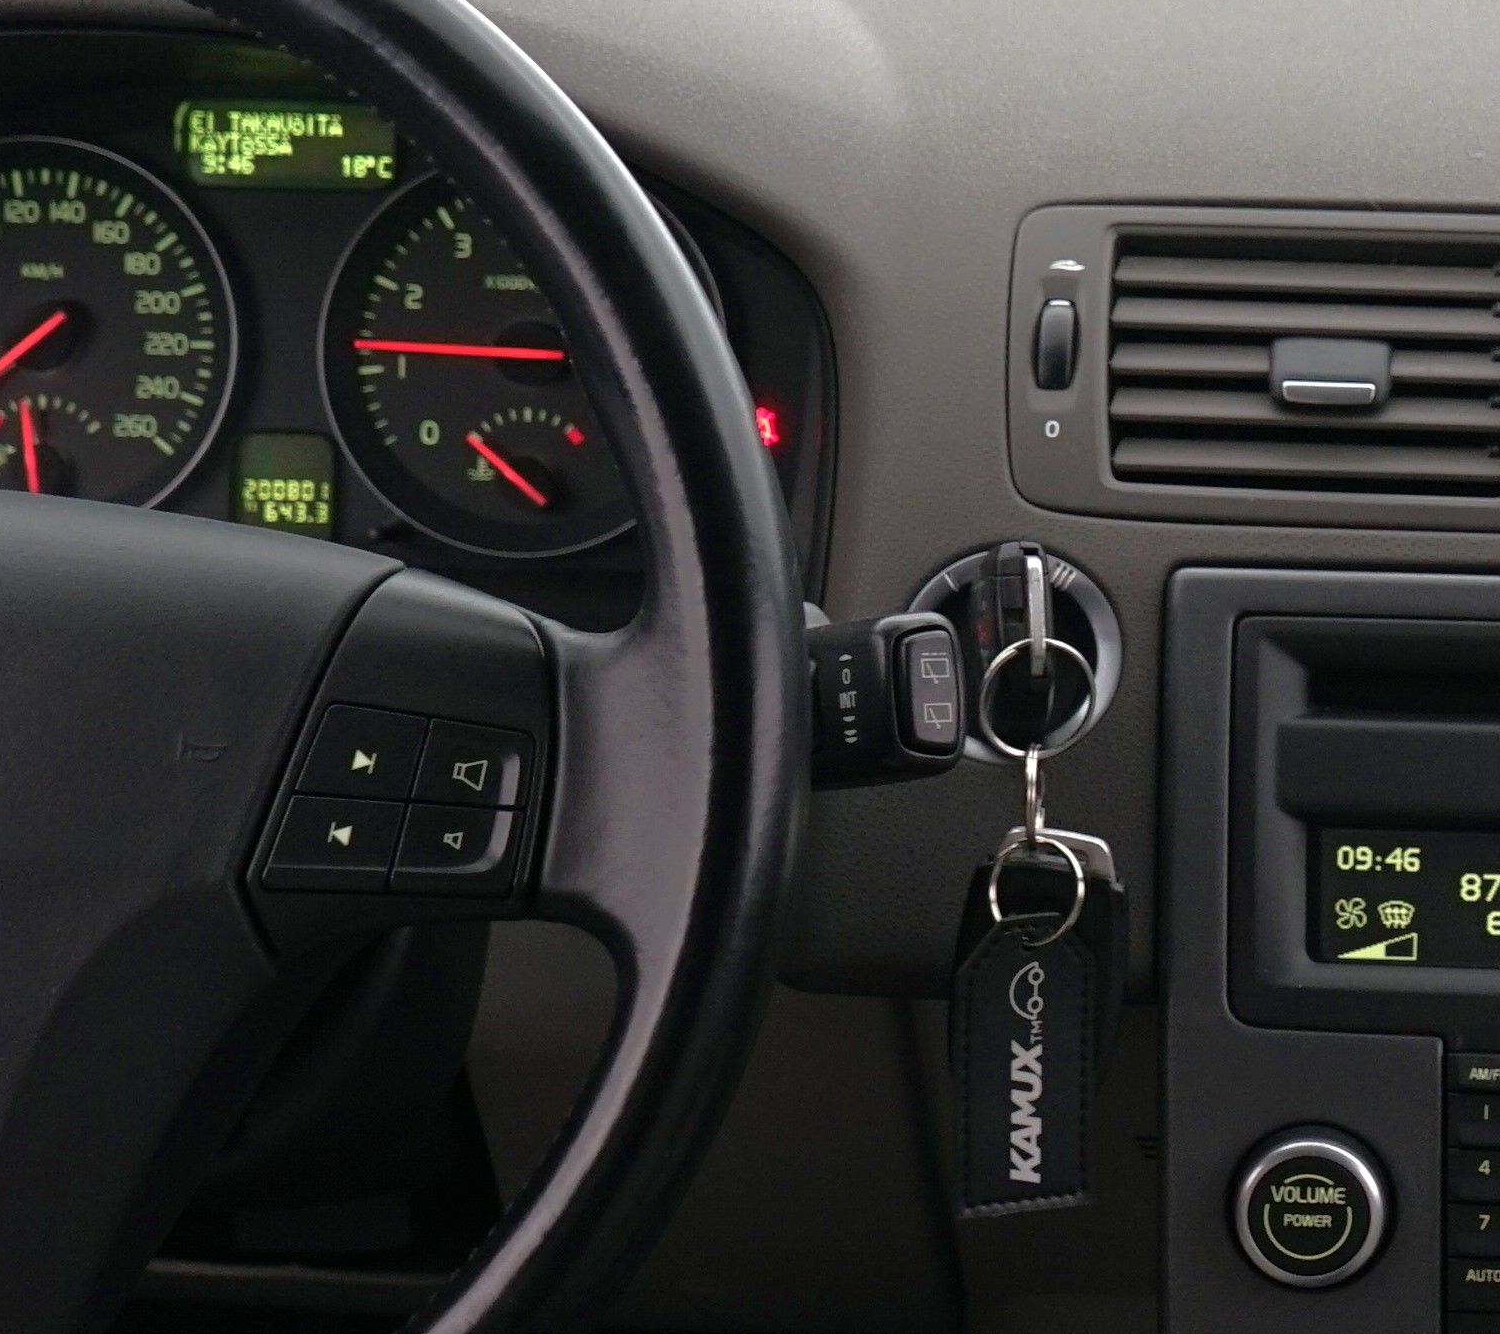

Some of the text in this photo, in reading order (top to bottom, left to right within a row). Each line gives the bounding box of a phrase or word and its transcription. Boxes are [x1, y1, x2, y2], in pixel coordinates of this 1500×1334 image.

[454, 232, 473, 259] 3
[135, 289, 181, 315] 200
[404, 283, 424, 310] 2
[397, 353, 407, 380] 1
[419, 419, 440, 446] 0
[1336, 845, 1421, 873] 09:46
[1009, 1040, 1043, 1184] KAMUX
[1483, 1104, 1490, 1120] 1
[1477, 1159, 1491, 1175] 4
[1270, 1184, 1347, 1206] VOLUME
[1283, 1213, 1333, 1228] POWER
[1478, 1214, 1491, 1231] 7
